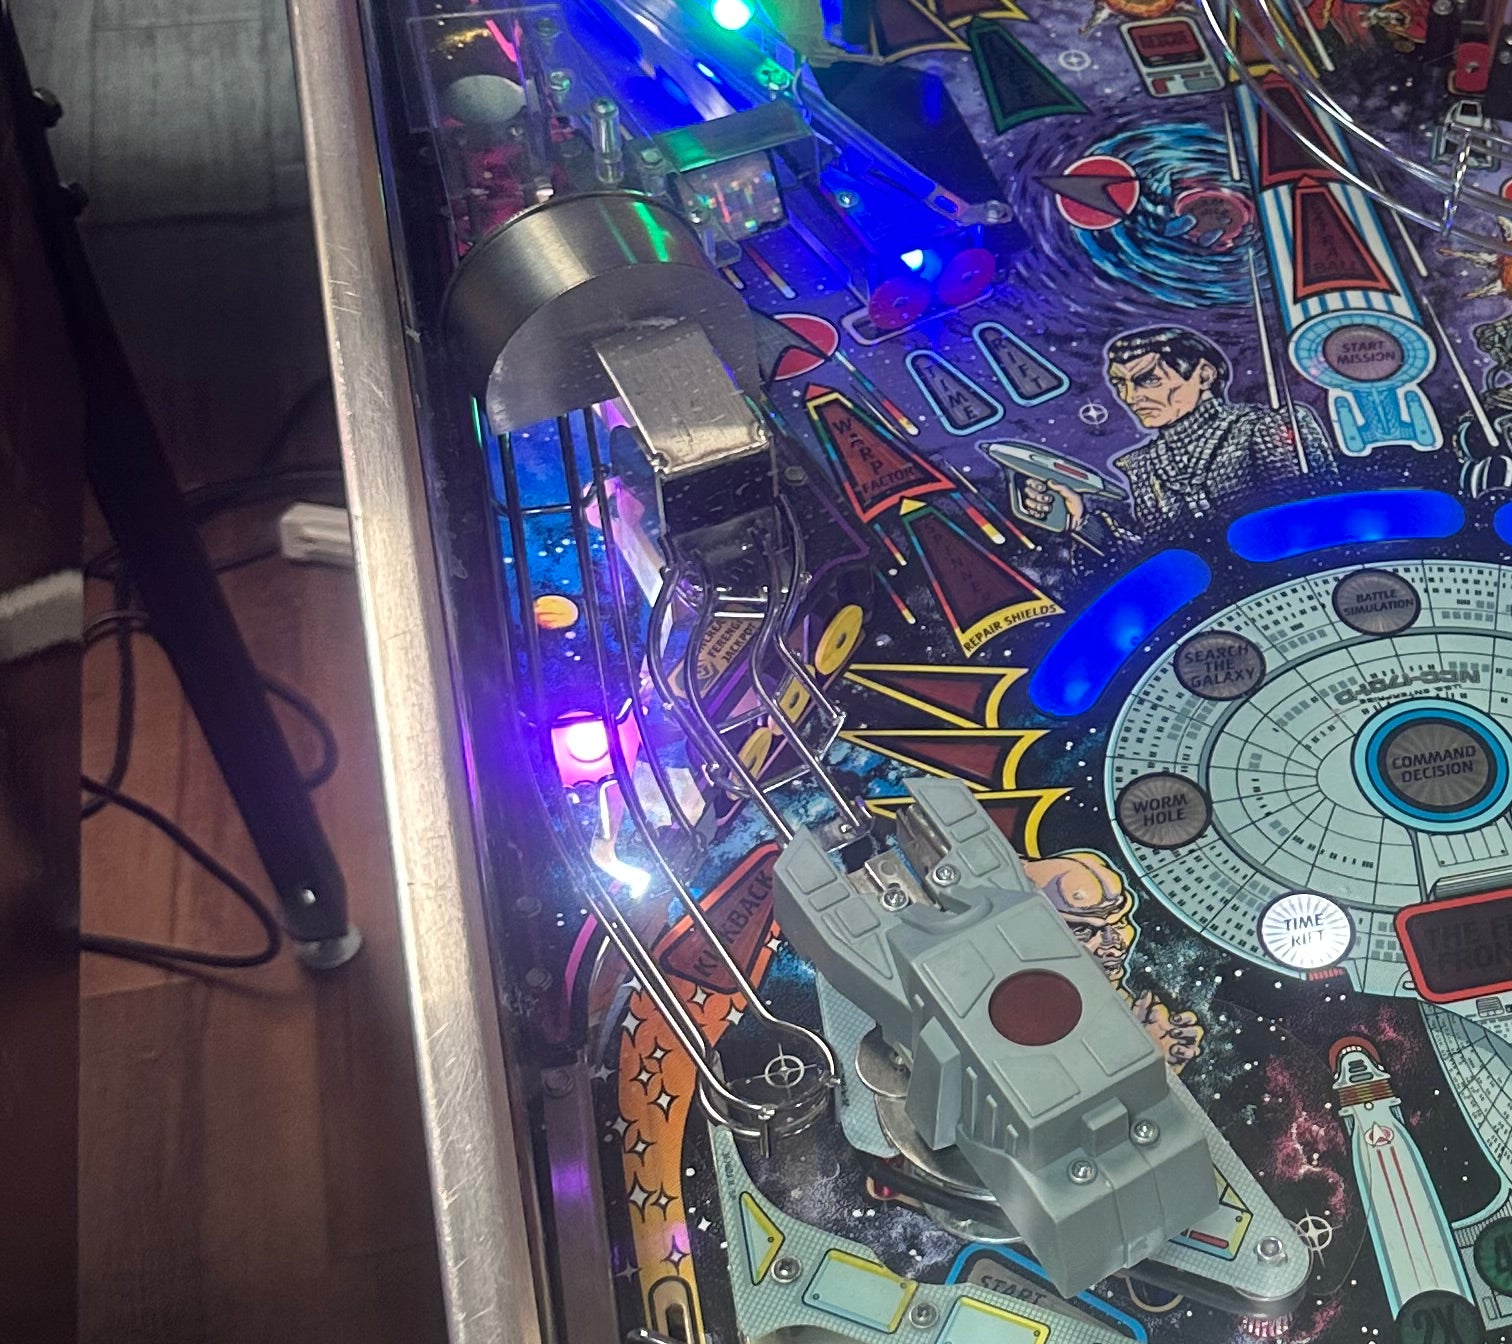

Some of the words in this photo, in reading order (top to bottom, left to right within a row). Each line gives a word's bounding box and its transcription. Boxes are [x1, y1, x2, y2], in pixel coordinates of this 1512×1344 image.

[1341, 340, 1385, 354] START
[1337, 351, 1396, 365] MISSION
[862, 467, 915, 493] FACTOR
[1356, 589, 1397, 604] BATTLE
[1344, 598, 1414, 616] SIMULATION
[964, 621, 1003, 653] REPAIR
[1006, 604, 1057, 626] SHIELDS
[721, 623, 757, 663] JACKPOT
[1185, 645, 1249, 664] SEARCH
[1204, 658, 1234, 672] THE
[1191, 666, 1255, 689] GALAXY
[1392, 744, 1476, 770] COMMAND
[1403, 759, 1473, 783] DECISION
[1133, 793, 1188, 815] WORM
[1143, 808, 1185, 827] HOLE
[1284, 913, 1323, 932] TIME
